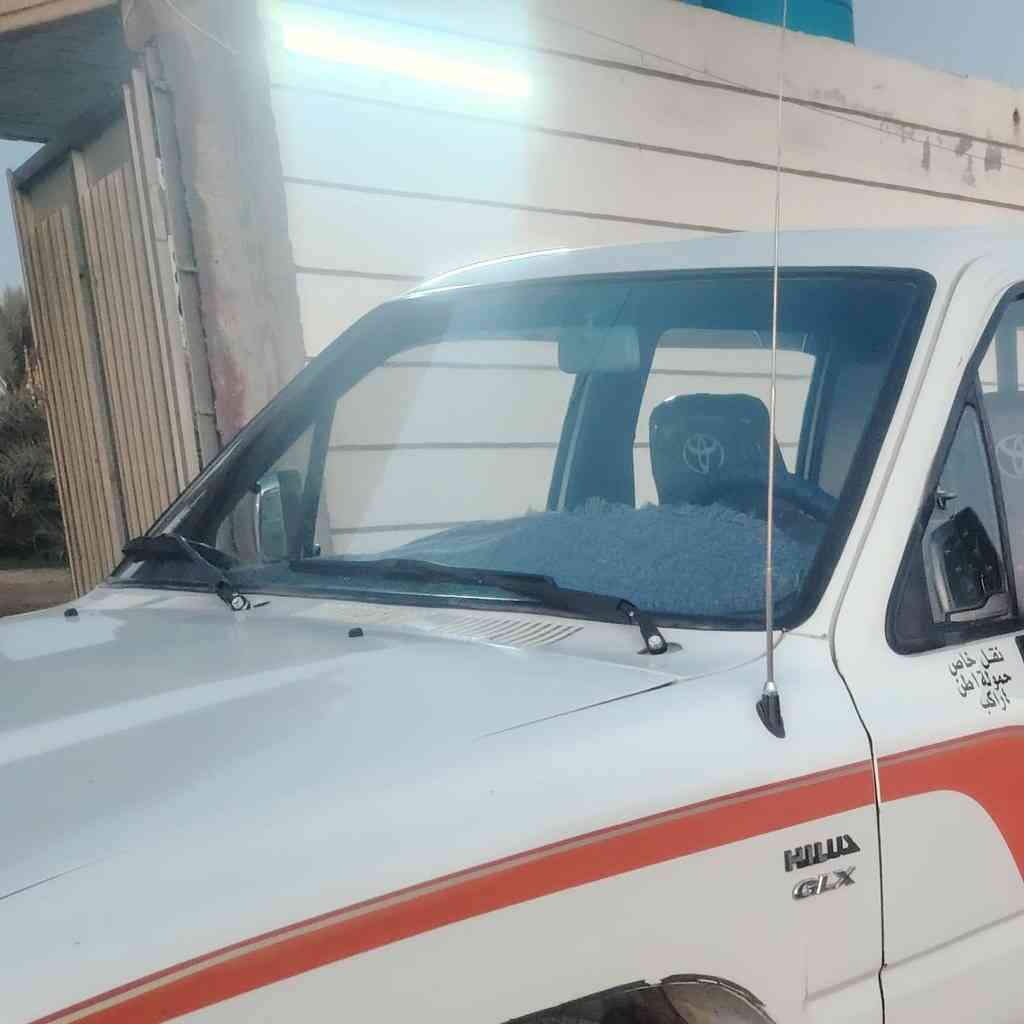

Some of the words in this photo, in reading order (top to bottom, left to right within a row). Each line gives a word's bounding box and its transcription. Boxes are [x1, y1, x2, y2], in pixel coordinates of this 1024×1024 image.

[948, 651, 977, 677] خاص
[980, 646, 1005, 670] نقل
[976, 669, 1012, 690] حمولة
[791, 865, 857, 901] GLX
